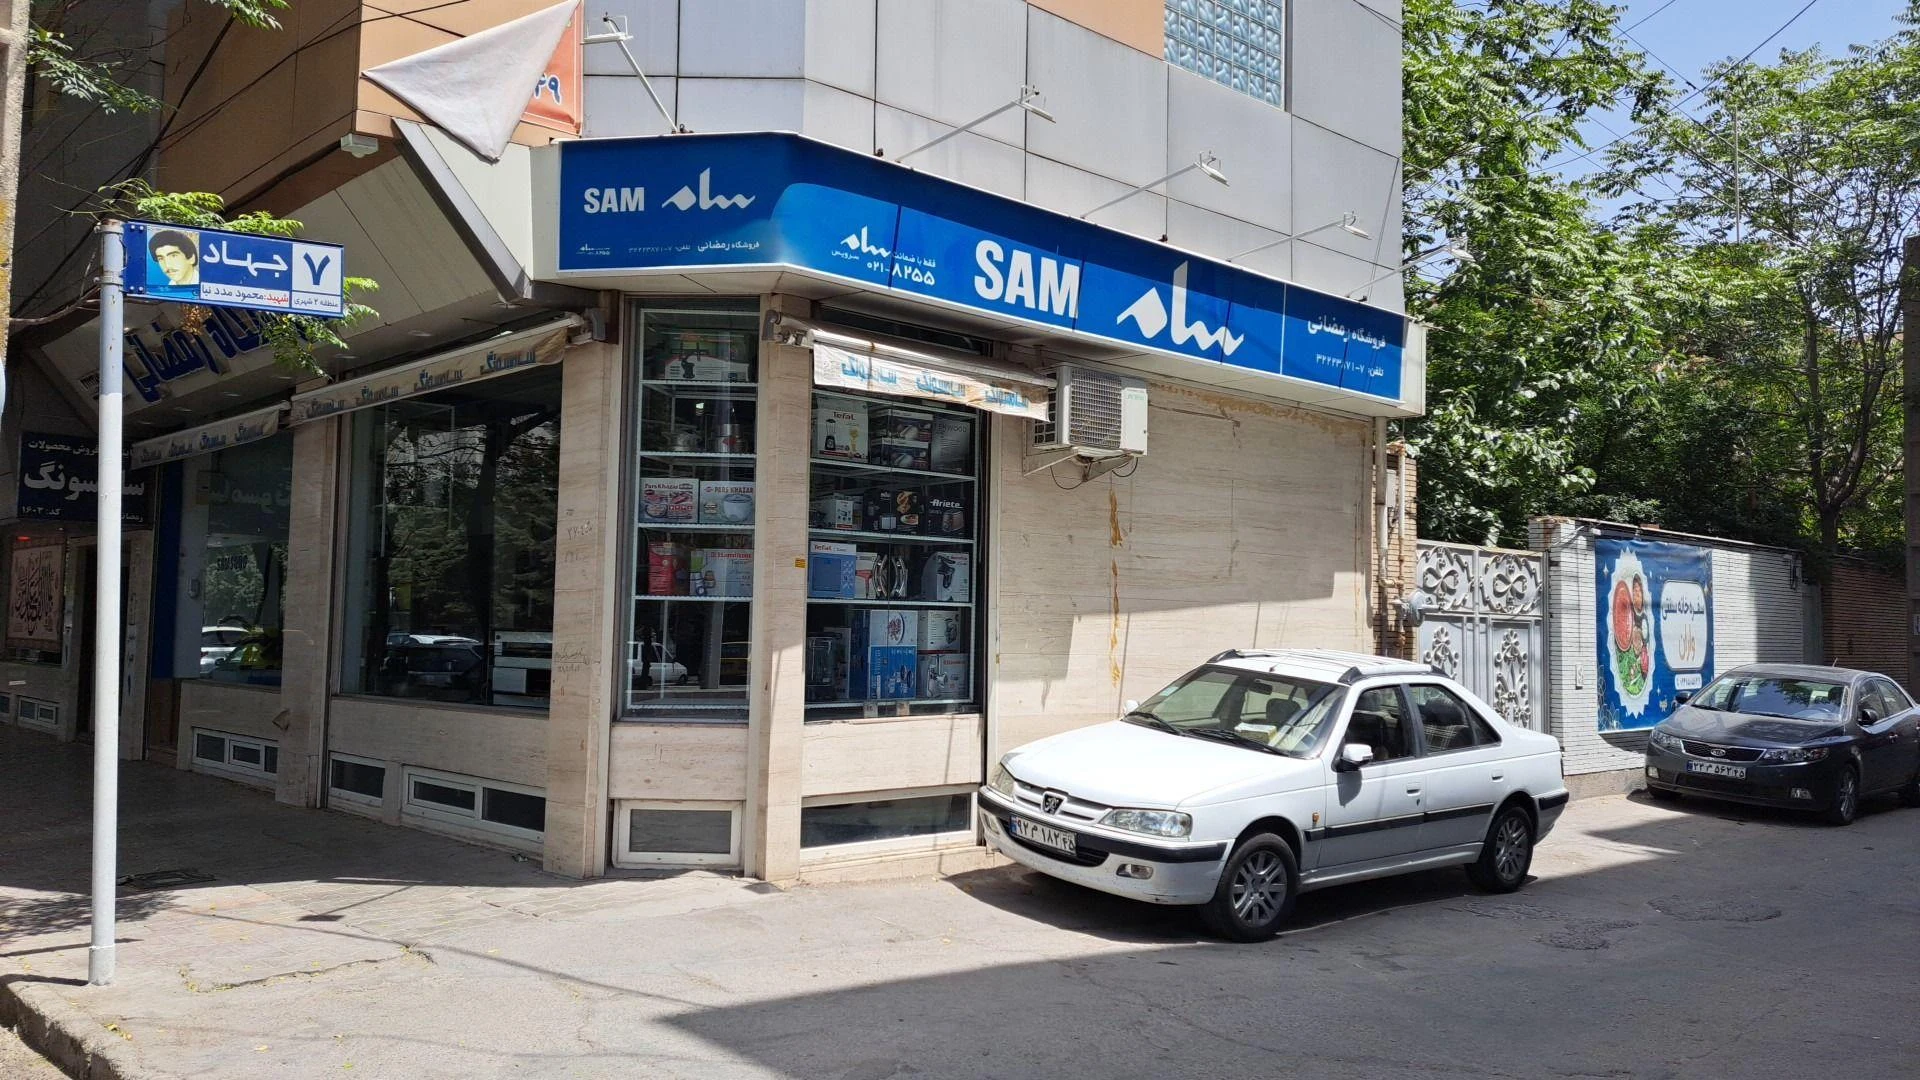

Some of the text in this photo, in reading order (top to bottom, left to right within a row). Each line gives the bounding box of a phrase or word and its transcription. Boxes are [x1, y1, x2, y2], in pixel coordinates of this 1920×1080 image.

[583, 186, 645, 214] SAM
[661, 167, 756, 211] سام
[696, 239, 730, 252] رمضانی
[731, 240, 760, 250] فروشگاه
[831, 250, 860, 260] سرویس
[840, 225, 891, 258] سام
[202, 240, 289, 278] جهاد
[303, 252, 331, 286] ۷
[922, 257, 937, 268] فقط
[201, 285, 212, 297] نیا
[973, 239, 1081, 320] SAM
[235, 289, 264, 302] محمود
[1116, 260, 1245, 356] سام
[1307, 314, 1386, 350] فروشگاه رمضانی
[24, 460, 145, 501] ساسونگ
[929, 498, 965, 509] Ariete
[1041, 828, 1060, 847] ۱۸۲
